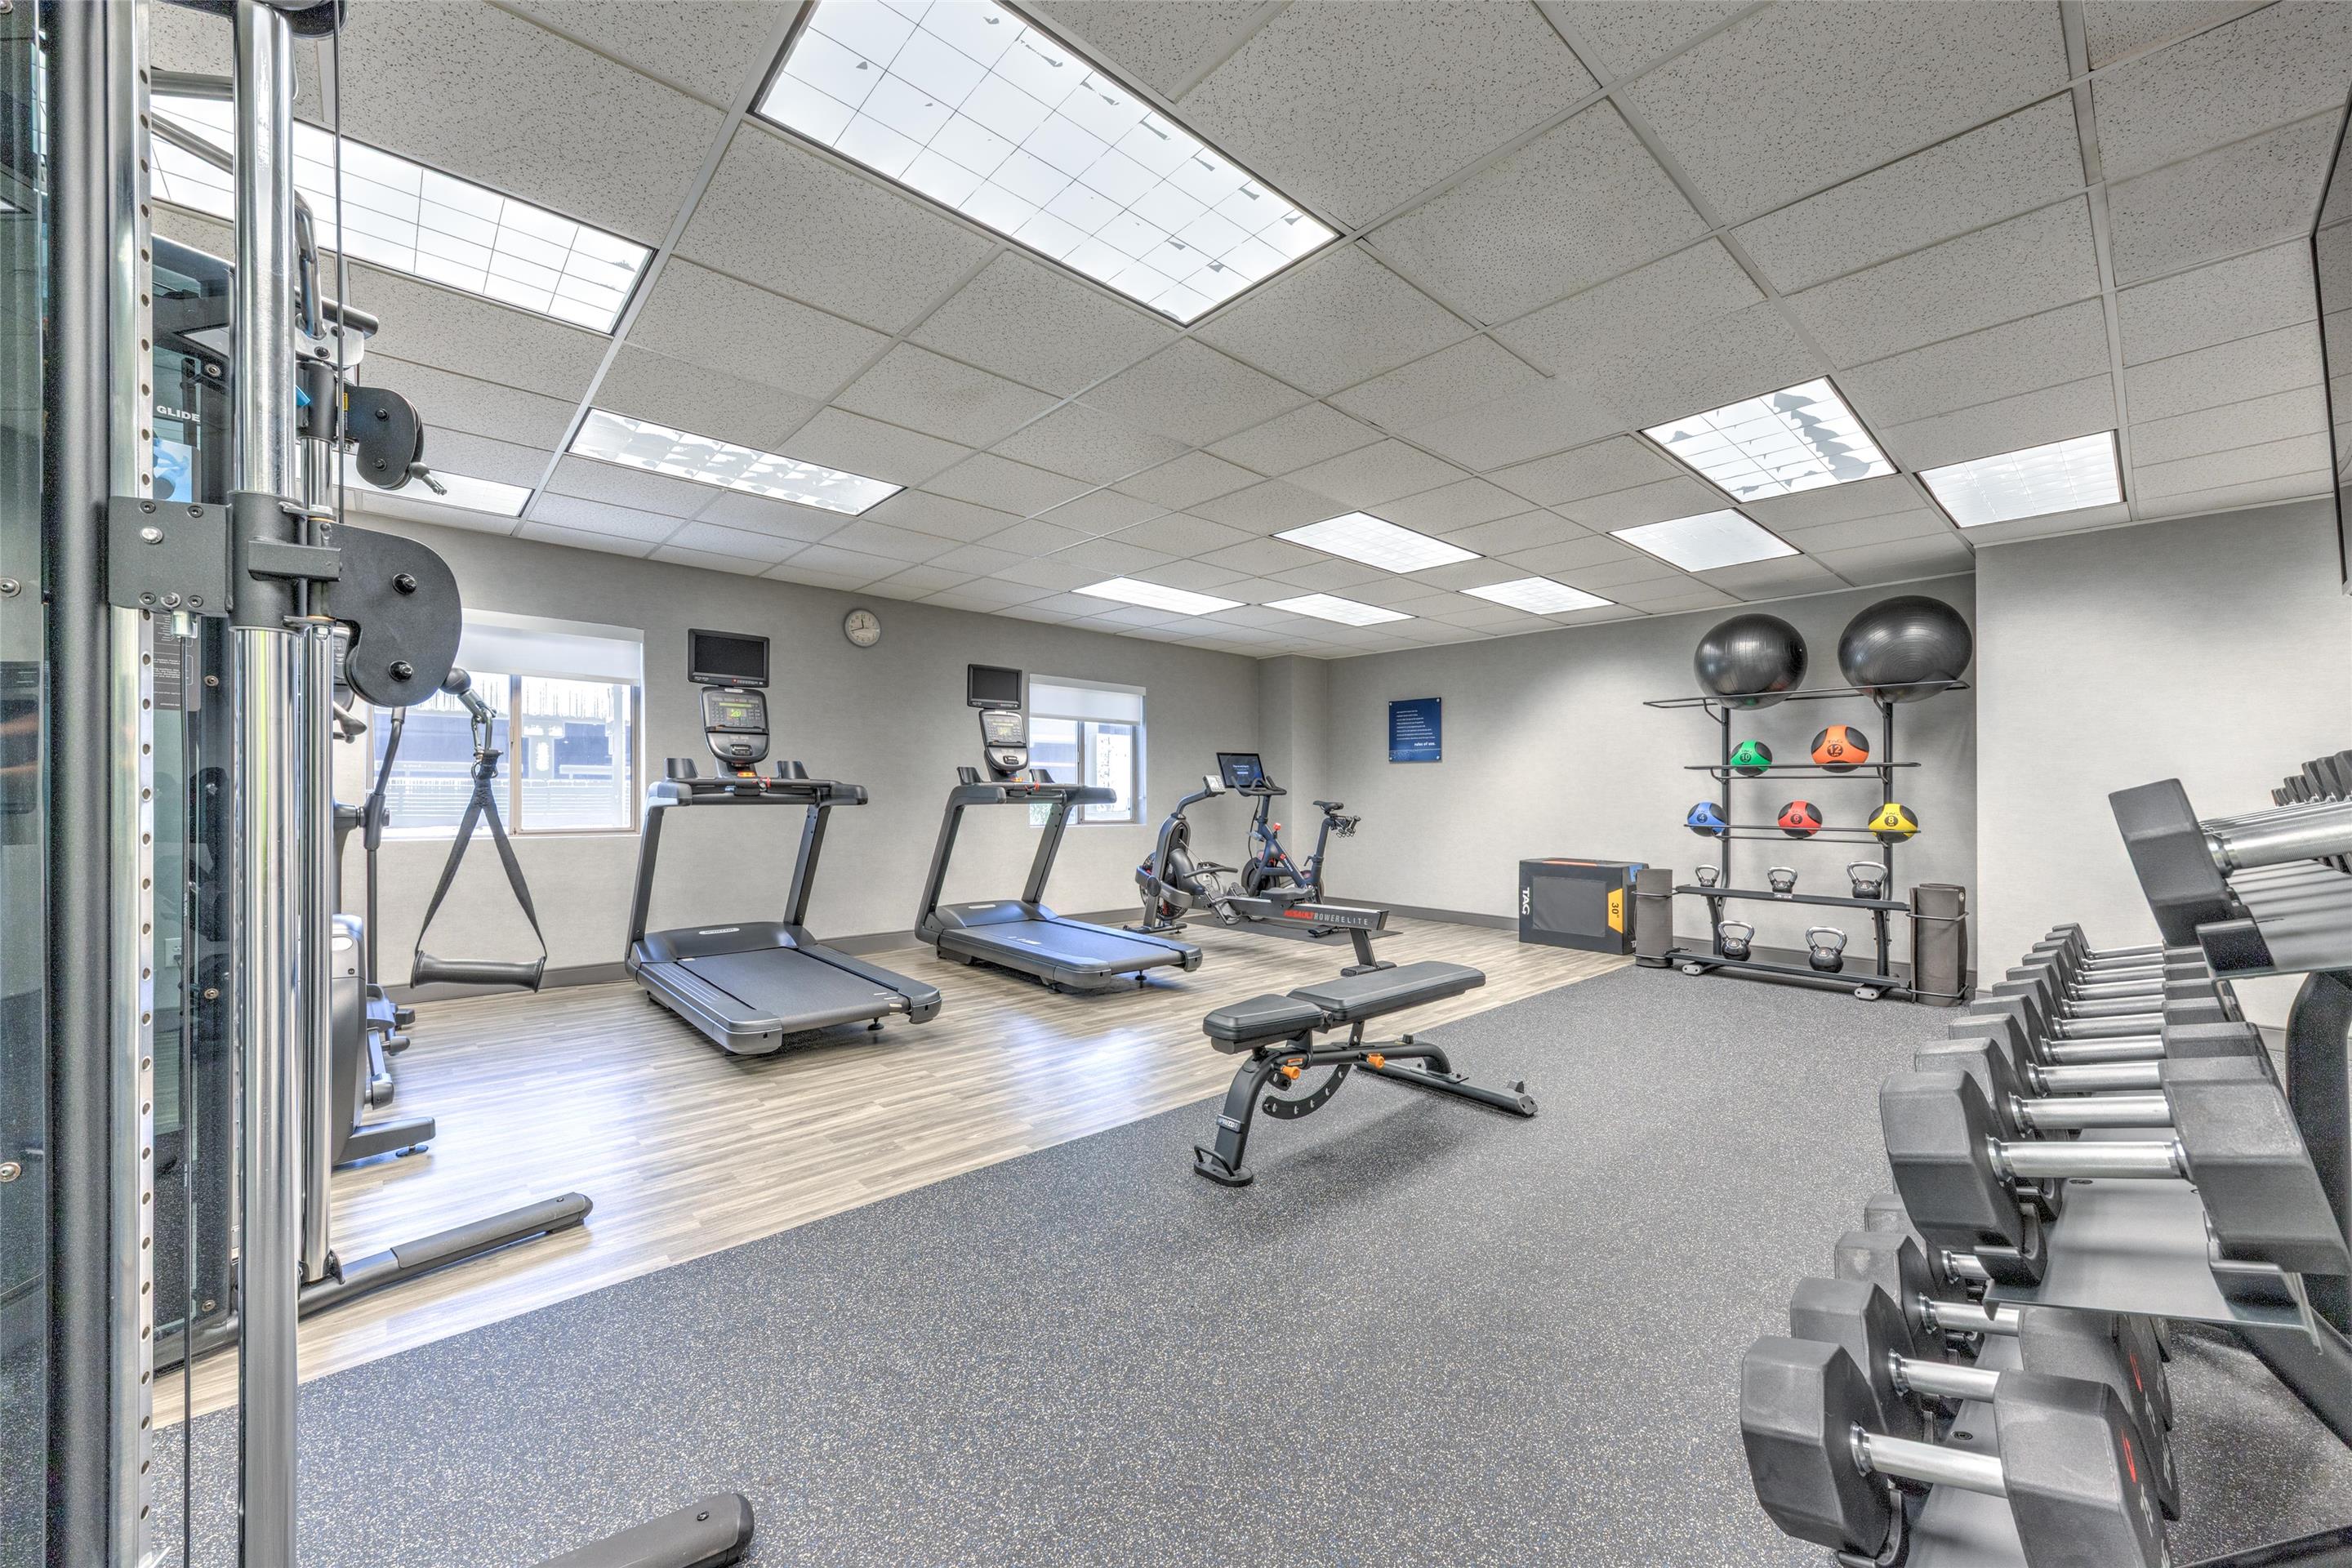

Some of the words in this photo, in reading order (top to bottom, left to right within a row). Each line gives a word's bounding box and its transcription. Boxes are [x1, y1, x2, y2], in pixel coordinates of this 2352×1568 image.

[156, 405, 201, 423] GLIDE
[1829, 744, 1842, 754] 12
[1521, 887, 1530, 915] TAG
